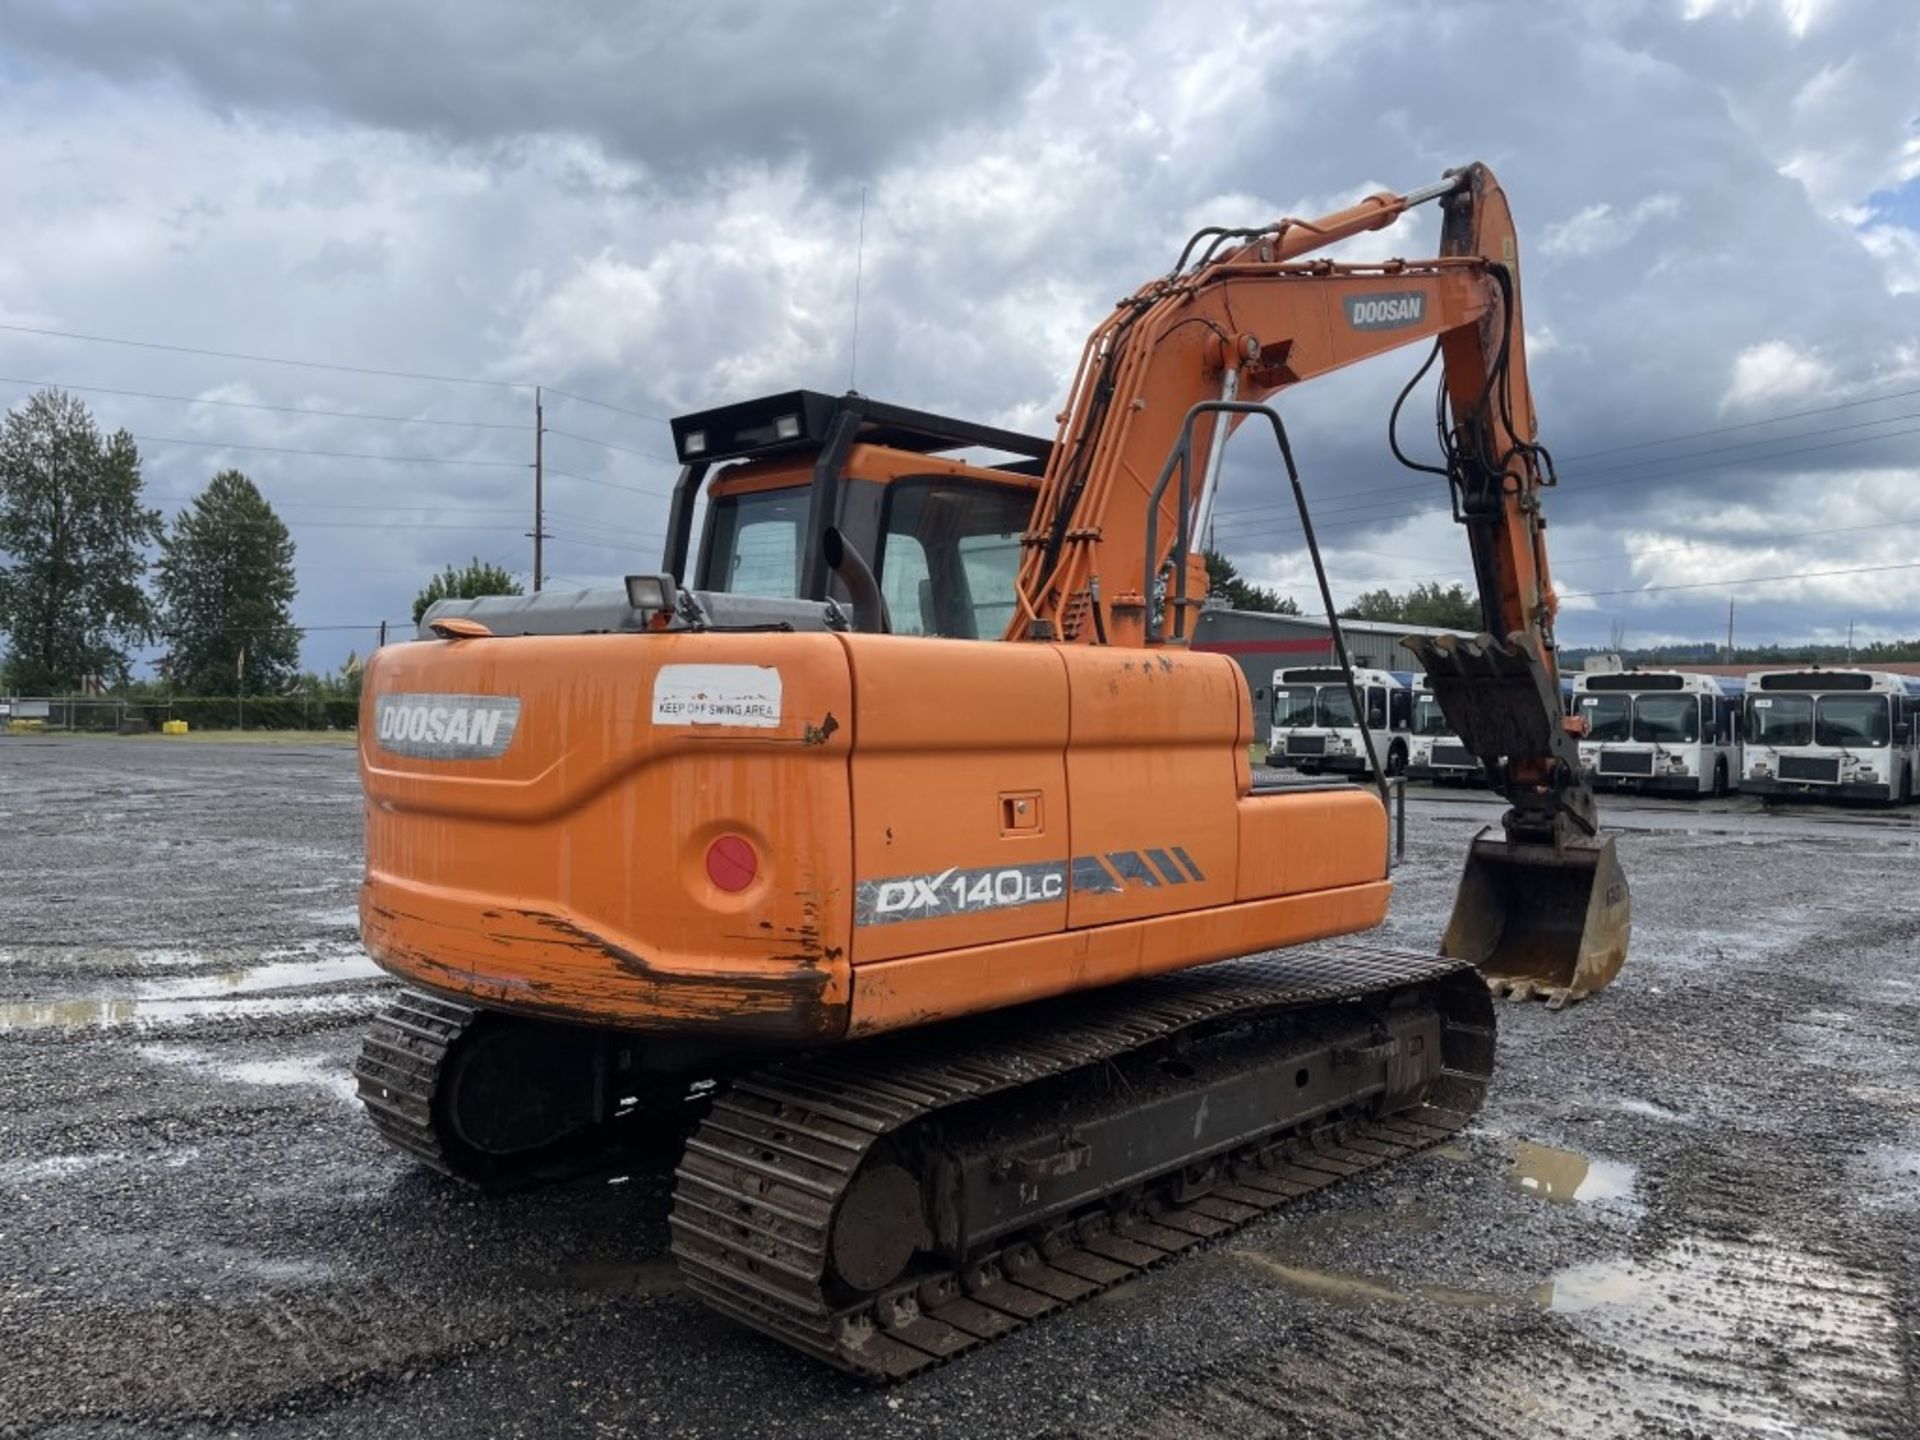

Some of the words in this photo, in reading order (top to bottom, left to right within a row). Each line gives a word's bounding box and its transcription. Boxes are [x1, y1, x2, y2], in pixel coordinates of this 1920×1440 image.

[1353, 298, 1421, 325] DOOSAN
[659, 702, 685, 714] KEEP
[687, 703, 706, 714] OFF
[709, 703, 742, 716] SWING
[744, 703, 774, 716] AREA
[381, 705, 501, 747] DOOSAN
